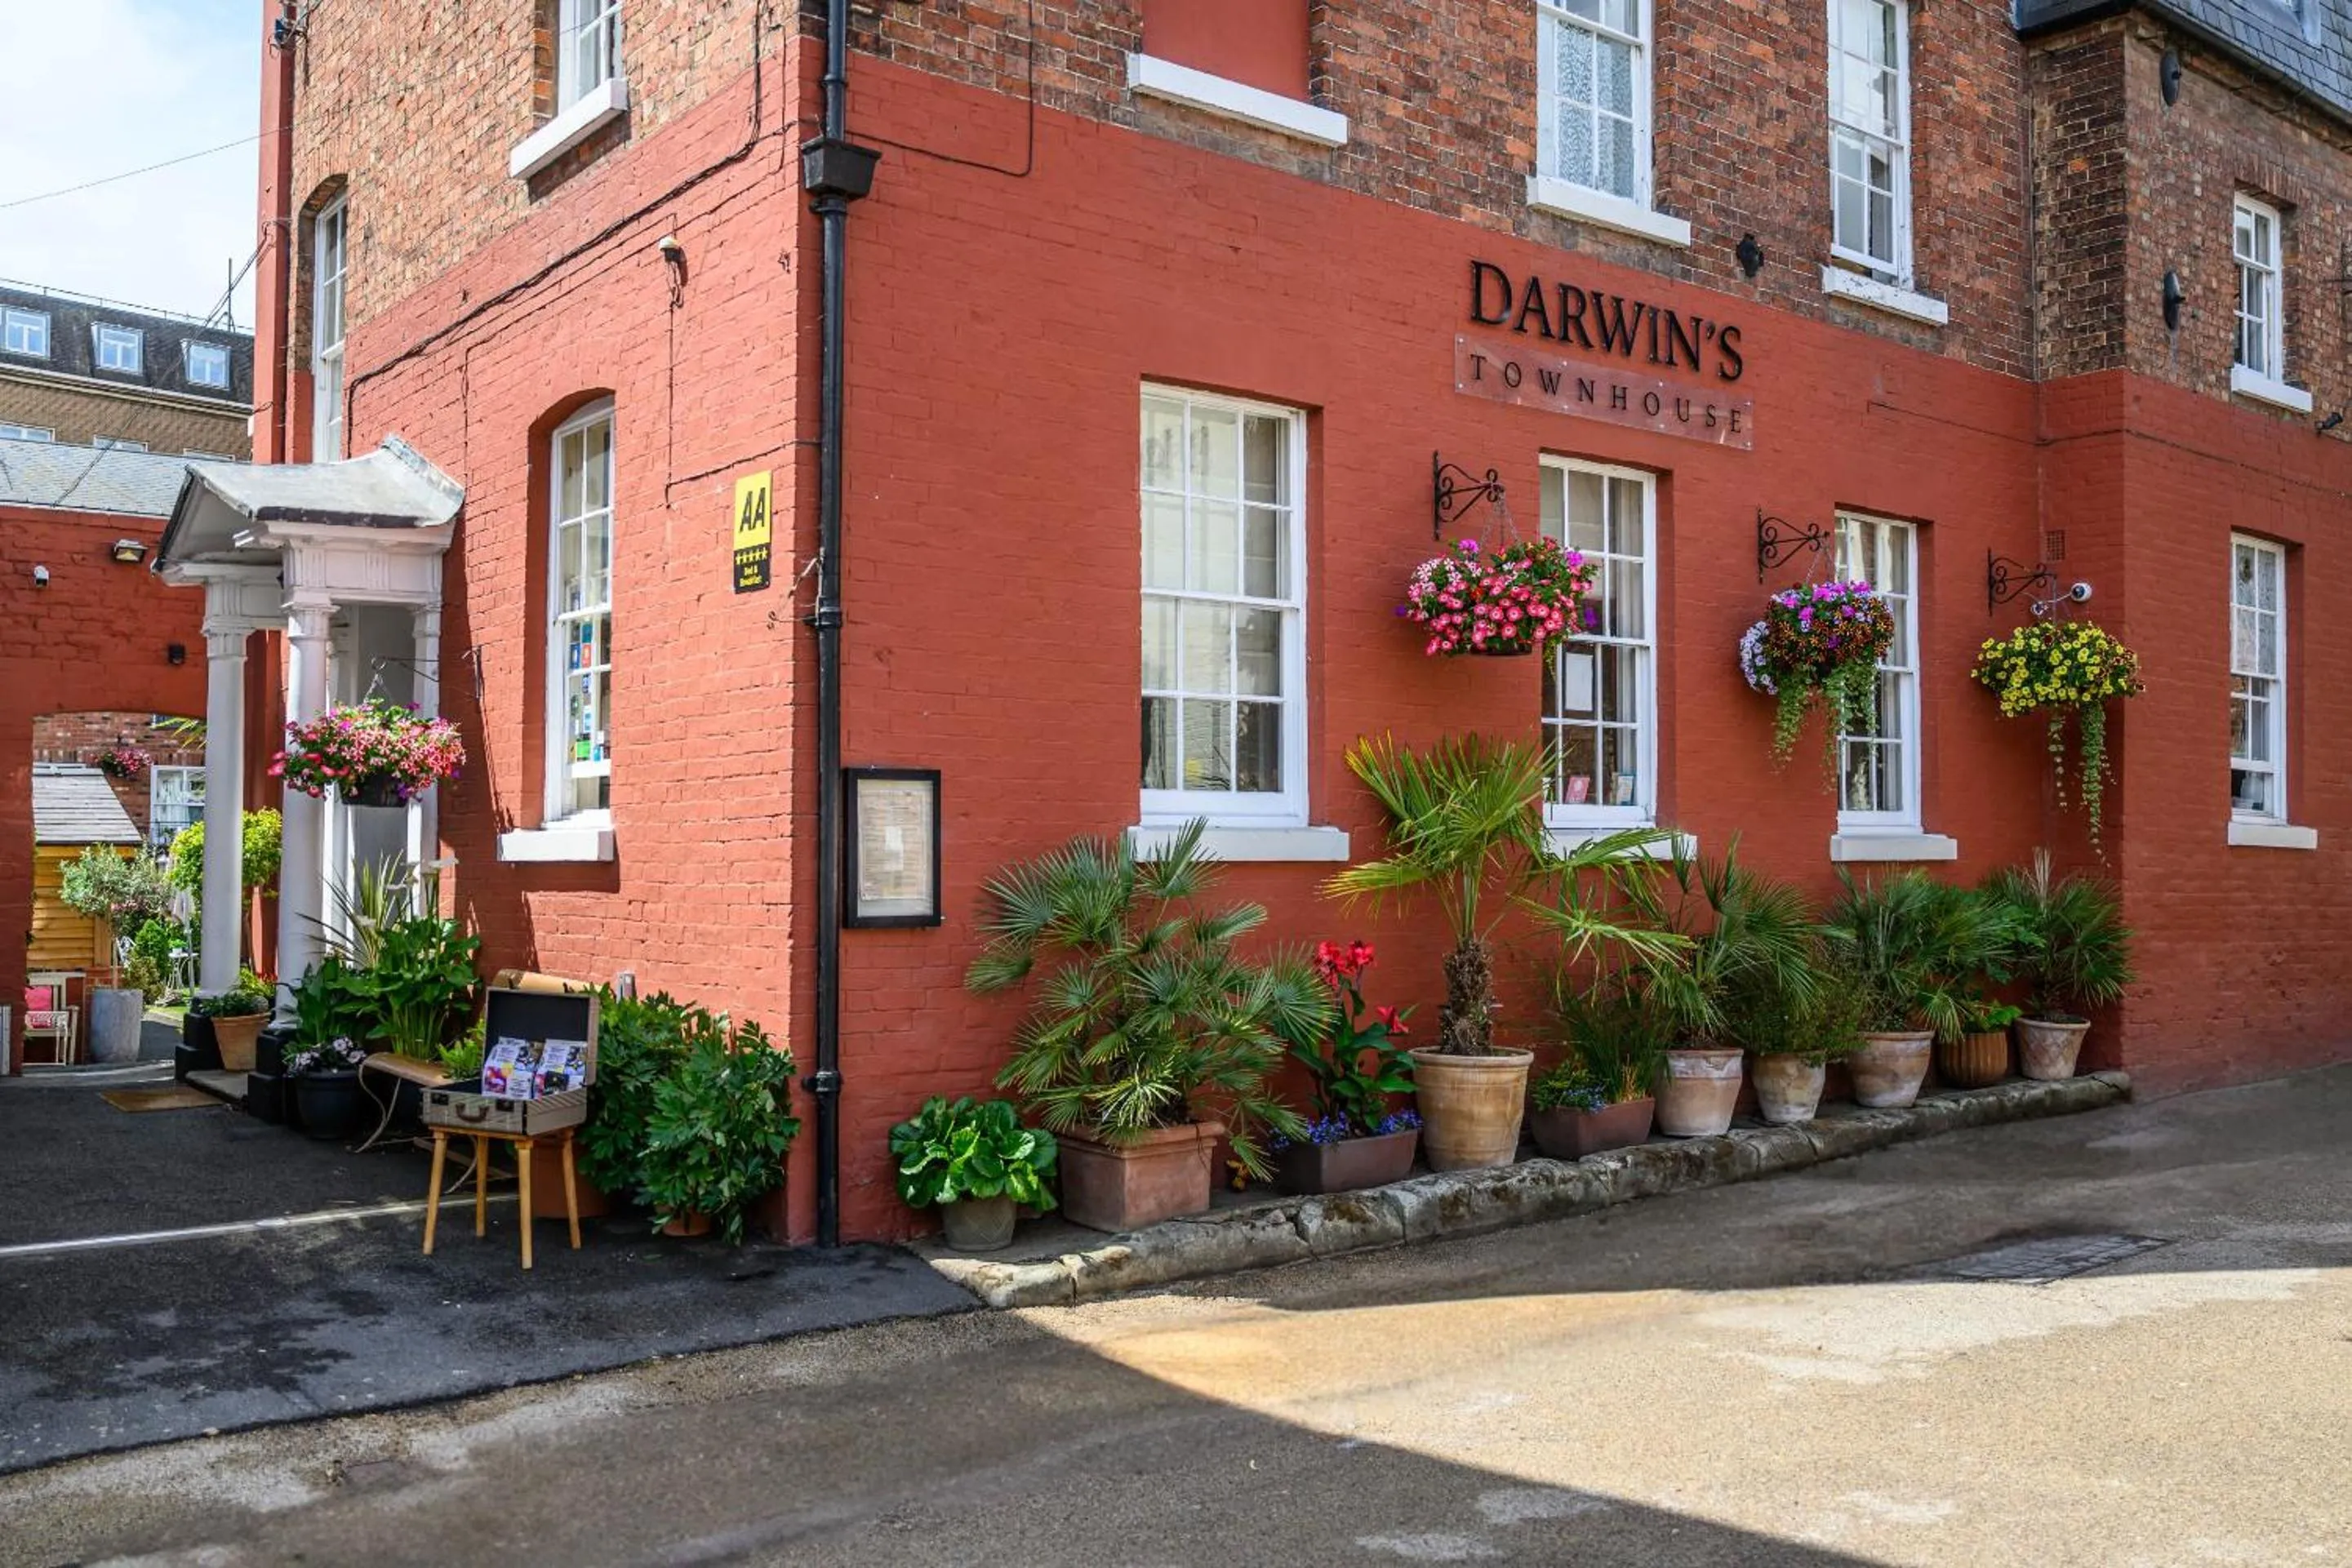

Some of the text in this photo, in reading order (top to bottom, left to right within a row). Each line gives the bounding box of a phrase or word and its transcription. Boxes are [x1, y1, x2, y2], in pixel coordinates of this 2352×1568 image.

[1469, 260, 1744, 380] DARWIN'S
[1470, 353, 1742, 433] TOWNHOUSE
[740, 487, 766, 532] AA
